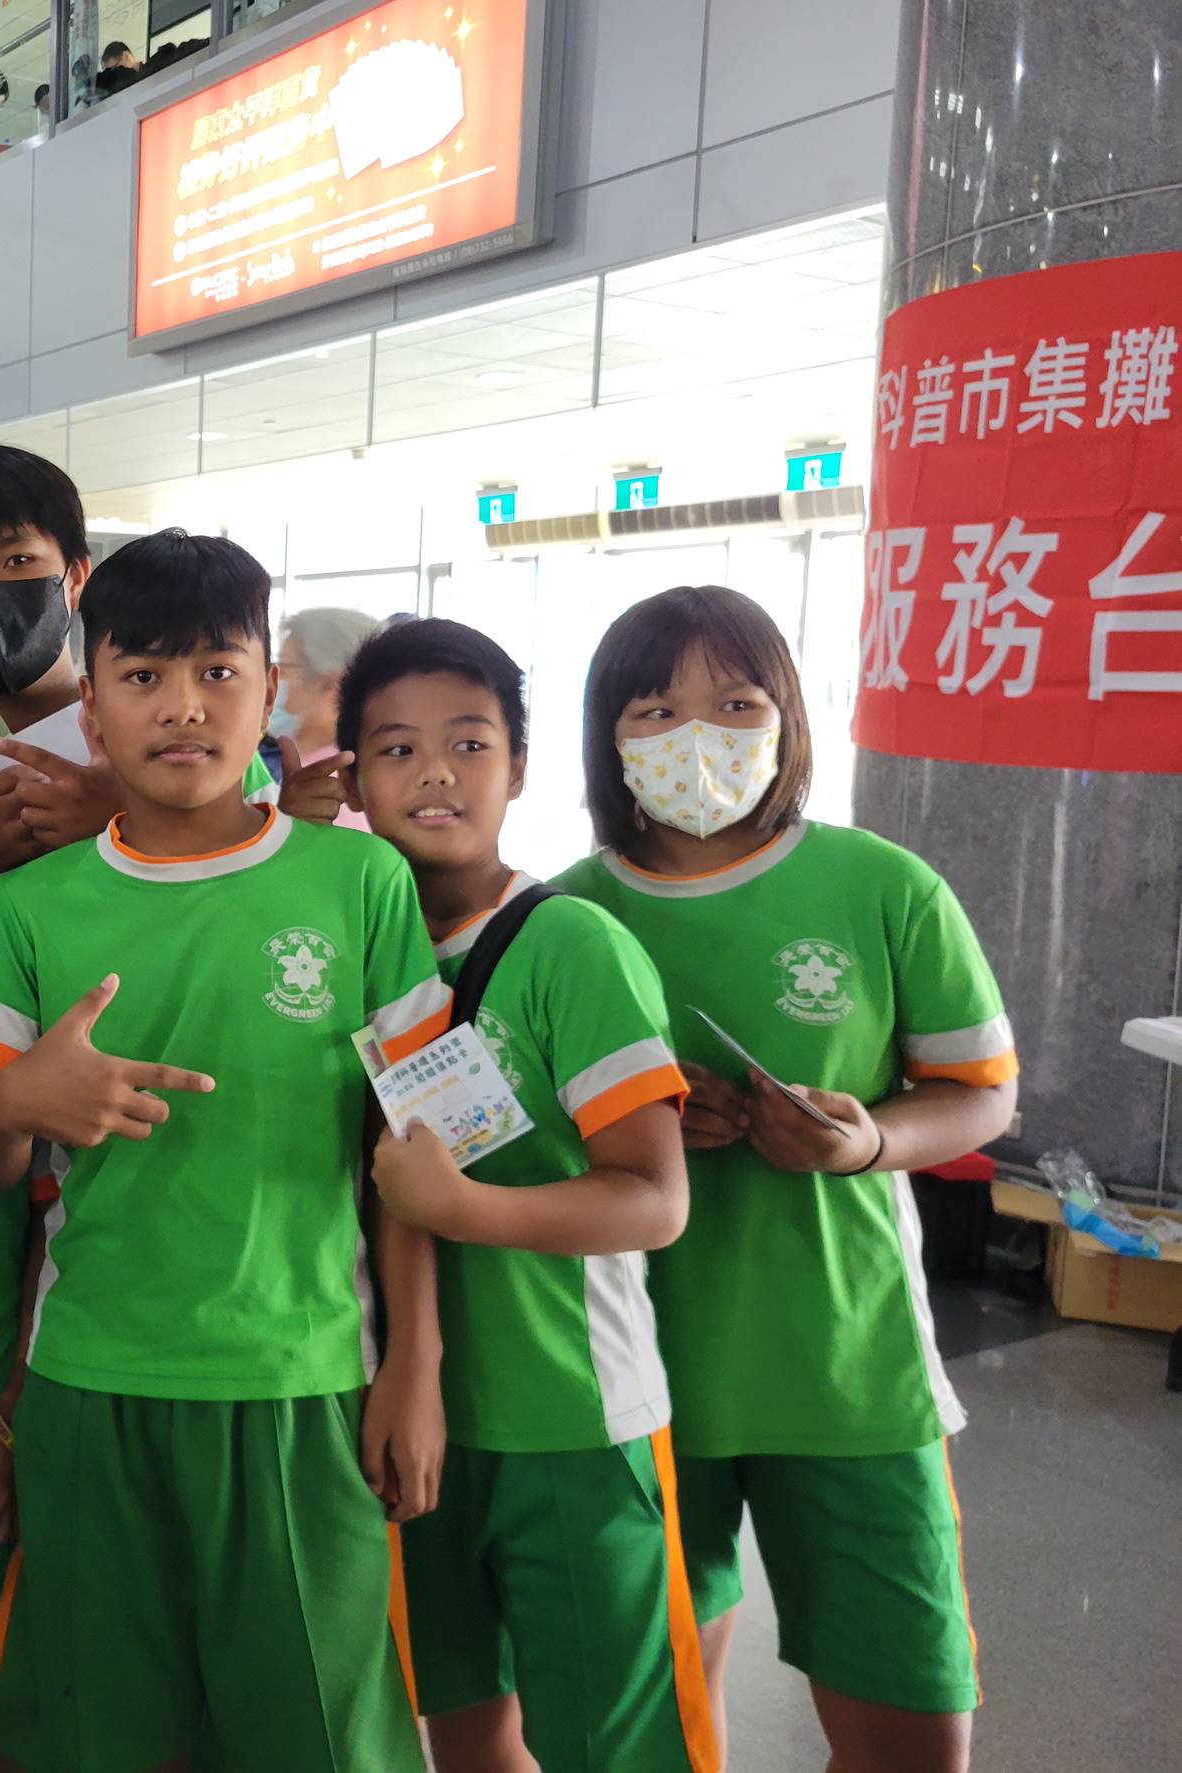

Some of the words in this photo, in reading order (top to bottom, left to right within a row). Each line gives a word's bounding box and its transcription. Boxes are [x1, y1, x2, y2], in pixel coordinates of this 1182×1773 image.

[877, 325, 1178, 450] 科普市集攤
[861, 512, 1182, 701] 服務台
